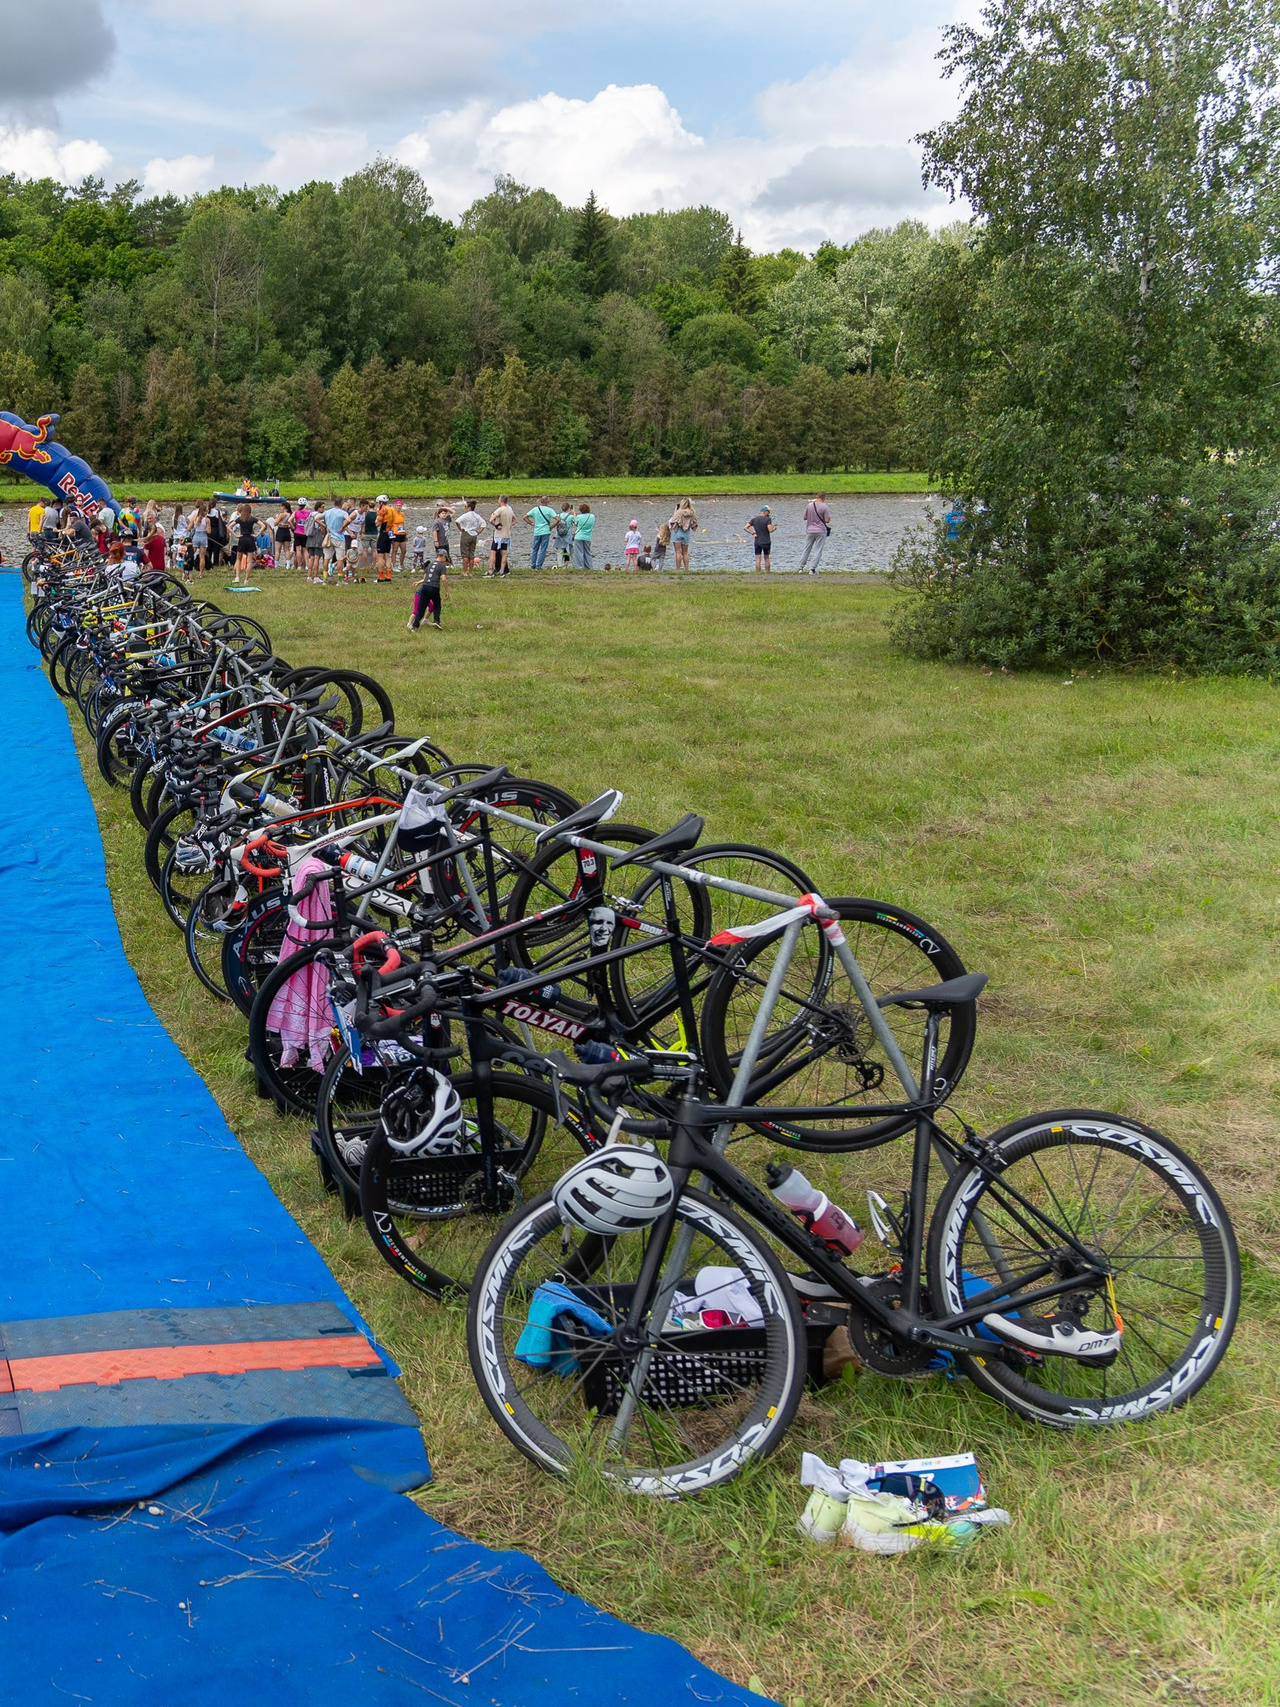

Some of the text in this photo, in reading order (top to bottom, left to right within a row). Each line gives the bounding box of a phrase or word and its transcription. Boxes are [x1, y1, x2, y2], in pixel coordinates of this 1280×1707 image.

[58, 472, 93, 506] Red
[502, 1001, 587, 1039] TOLYAN
[1078, 1337, 1113, 1352] DMT
